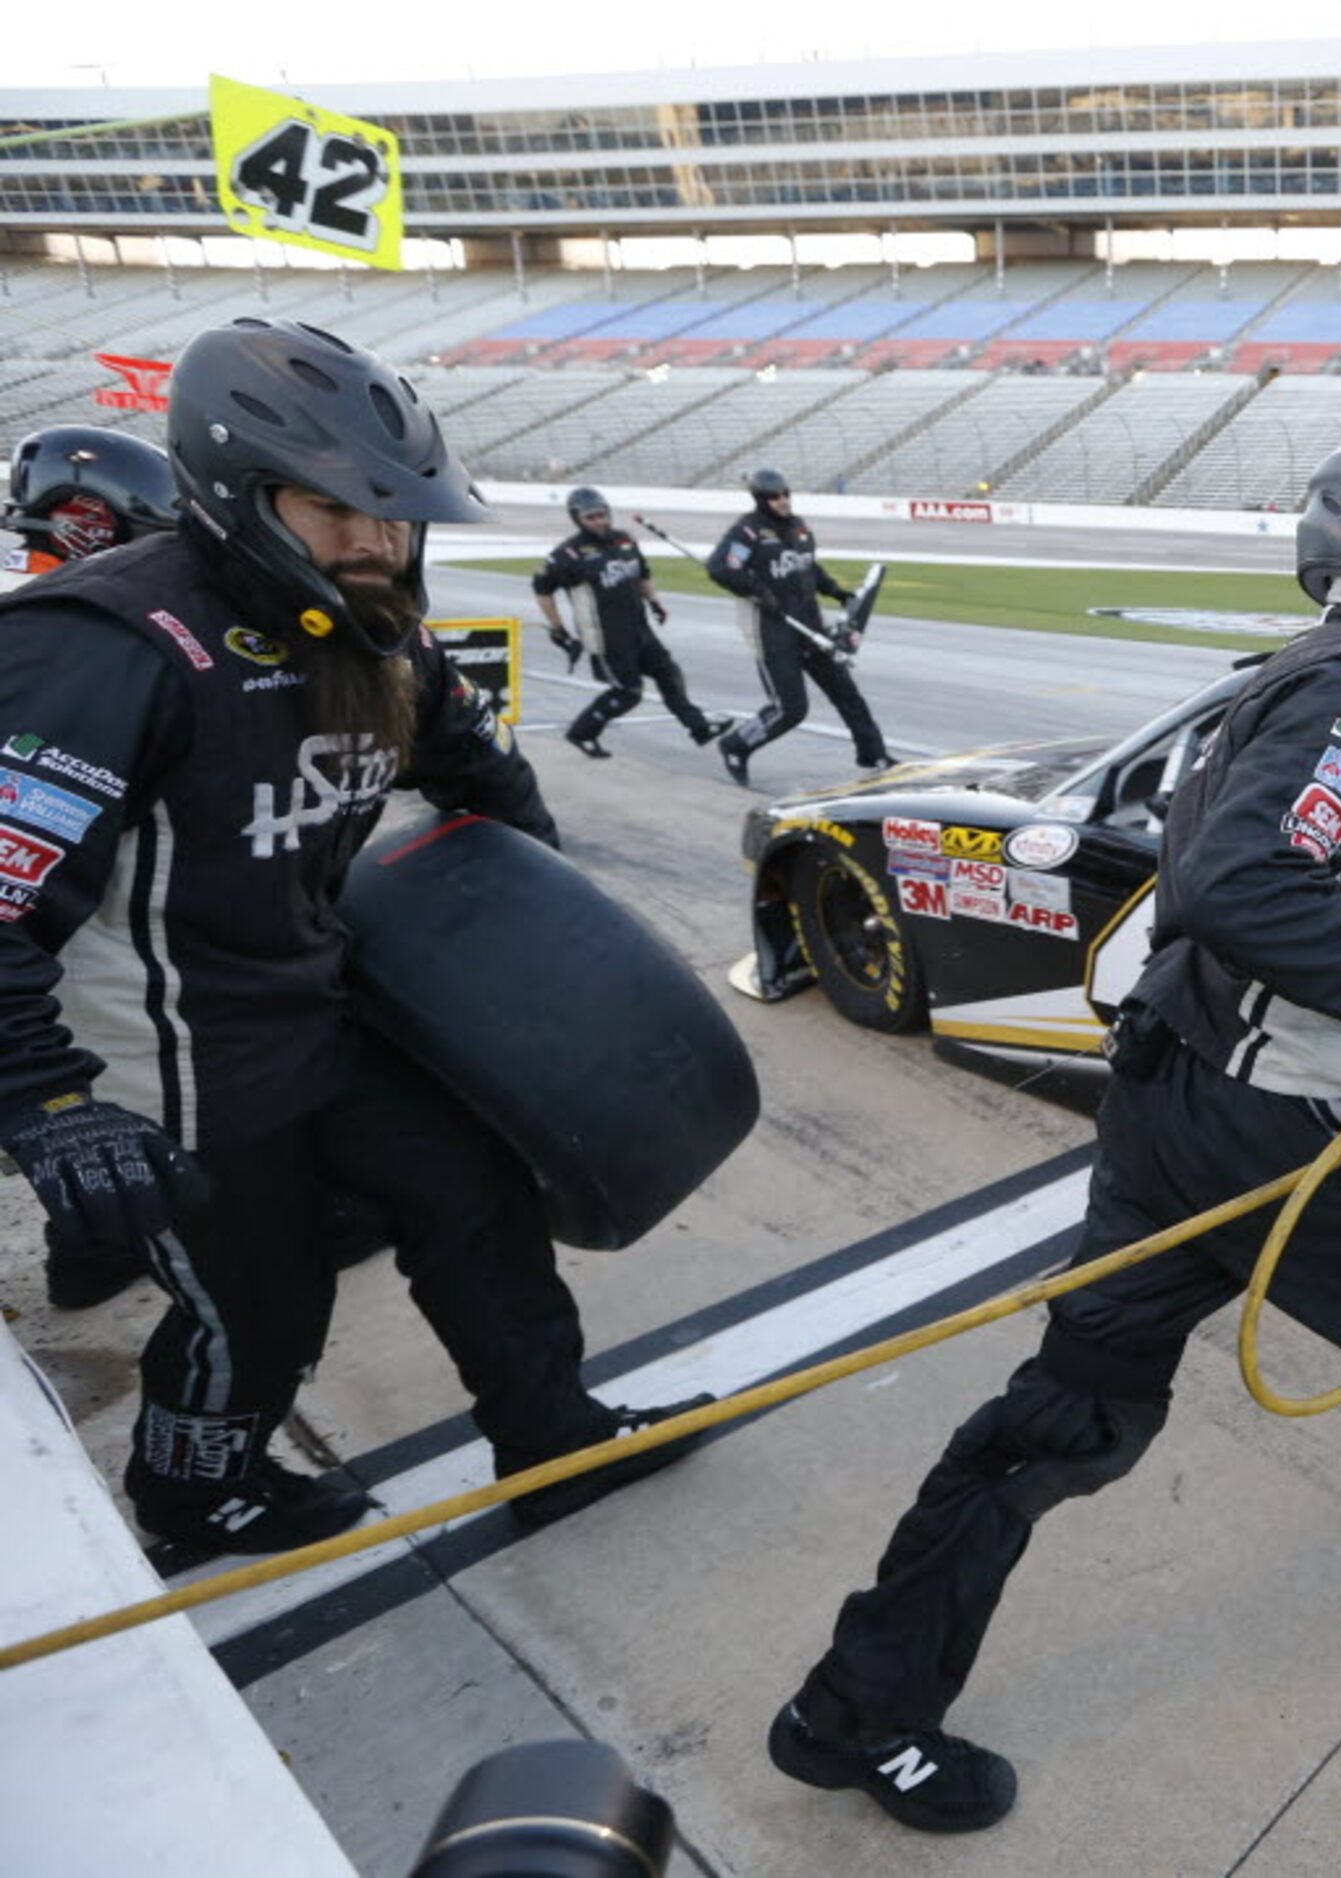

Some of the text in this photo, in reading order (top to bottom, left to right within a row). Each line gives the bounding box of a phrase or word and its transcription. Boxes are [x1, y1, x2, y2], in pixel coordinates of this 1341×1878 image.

[236, 122, 378, 237] 42
[915, 502, 987, 520] AAA.com
[886, 822, 939, 850] Holley
[0, 838, 41, 874] EM
[954, 861, 1004, 886] MSD
[902, 879, 947, 917] 3M
[1010, 903, 1076, 932] ARP
[877, 1746, 939, 1792] N
